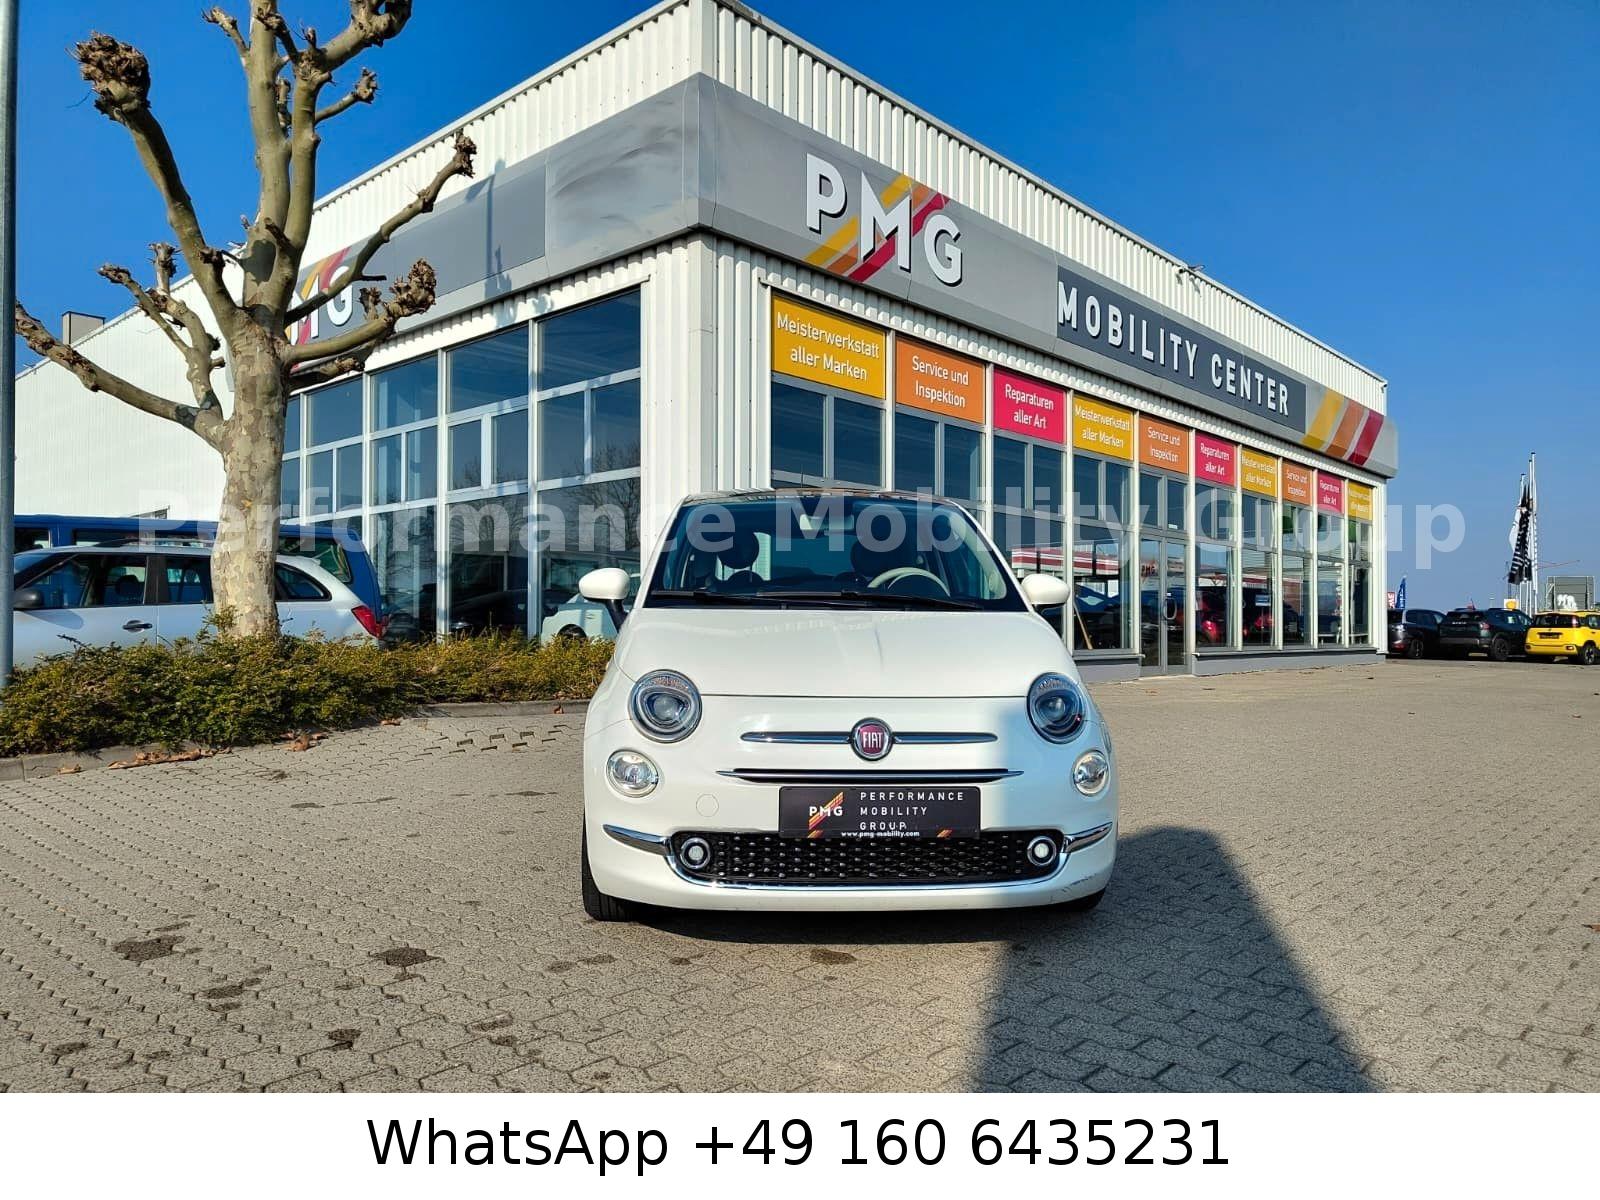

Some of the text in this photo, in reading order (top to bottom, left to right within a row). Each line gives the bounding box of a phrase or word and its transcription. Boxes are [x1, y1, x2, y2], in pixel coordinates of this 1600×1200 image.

[806, 152, 962, 286] PMG
[289, 266, 353, 345] MG
[777, 312, 880, 358] Meisterwerkstatt
[1058, 281, 1289, 416] MOBILITY CENTER
[790, 345, 867, 380] aller Marken
[912, 355, 969, 385] Service und
[915, 380, 966, 407] Inspektion
[1005, 383, 1054, 410] Reparaturen
[1014, 410, 1047, 429] aller Art
[1075, 404, 1130, 431] Meisterwerkstatt
[1082, 423, 1124, 448] aller Marken
[1147, 426, 1181, 446] Service und
[1151, 444, 1179, 462] Inspektion
[1200, 442, 1230, 460] Reparaturen
[1205, 461, 1217, 473] aller
[862, 731, 883, 748] FIAT
[860, 791, 964, 801] PERFORMANCE
[809, 805, 844, 817] PMG
[860, 806, 928, 816] MOBILITY
[859, 821, 907, 831] GROUP
